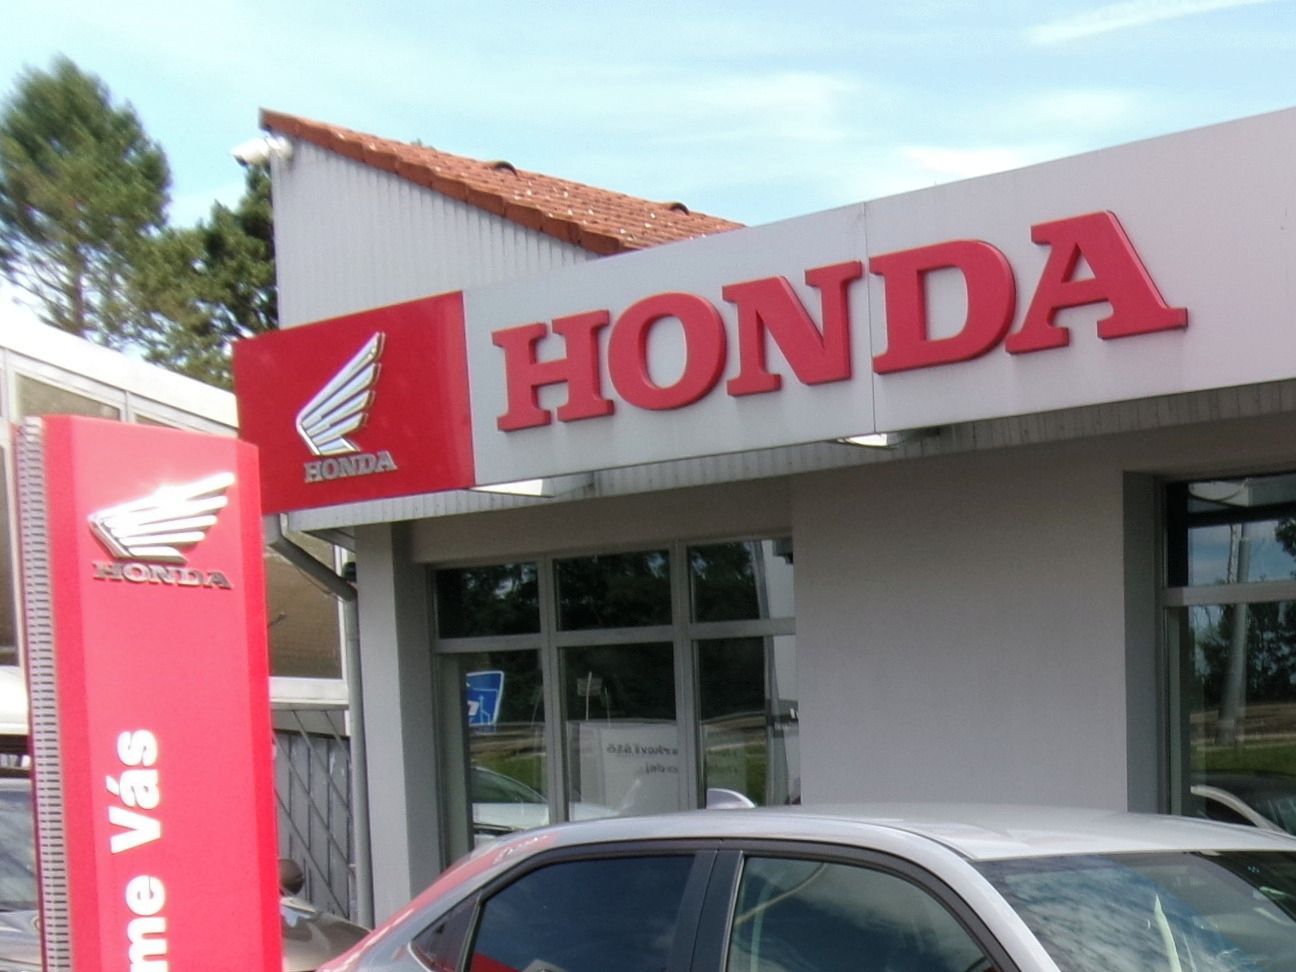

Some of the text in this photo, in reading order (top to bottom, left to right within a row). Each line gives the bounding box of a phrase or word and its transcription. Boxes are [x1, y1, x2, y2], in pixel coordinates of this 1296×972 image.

[492, 210, 1188, 432] HONDA
[304, 450, 398, 483] HONDA
[92, 560, 232, 590] HONDA
[106, 729, 163, 854] Vás
